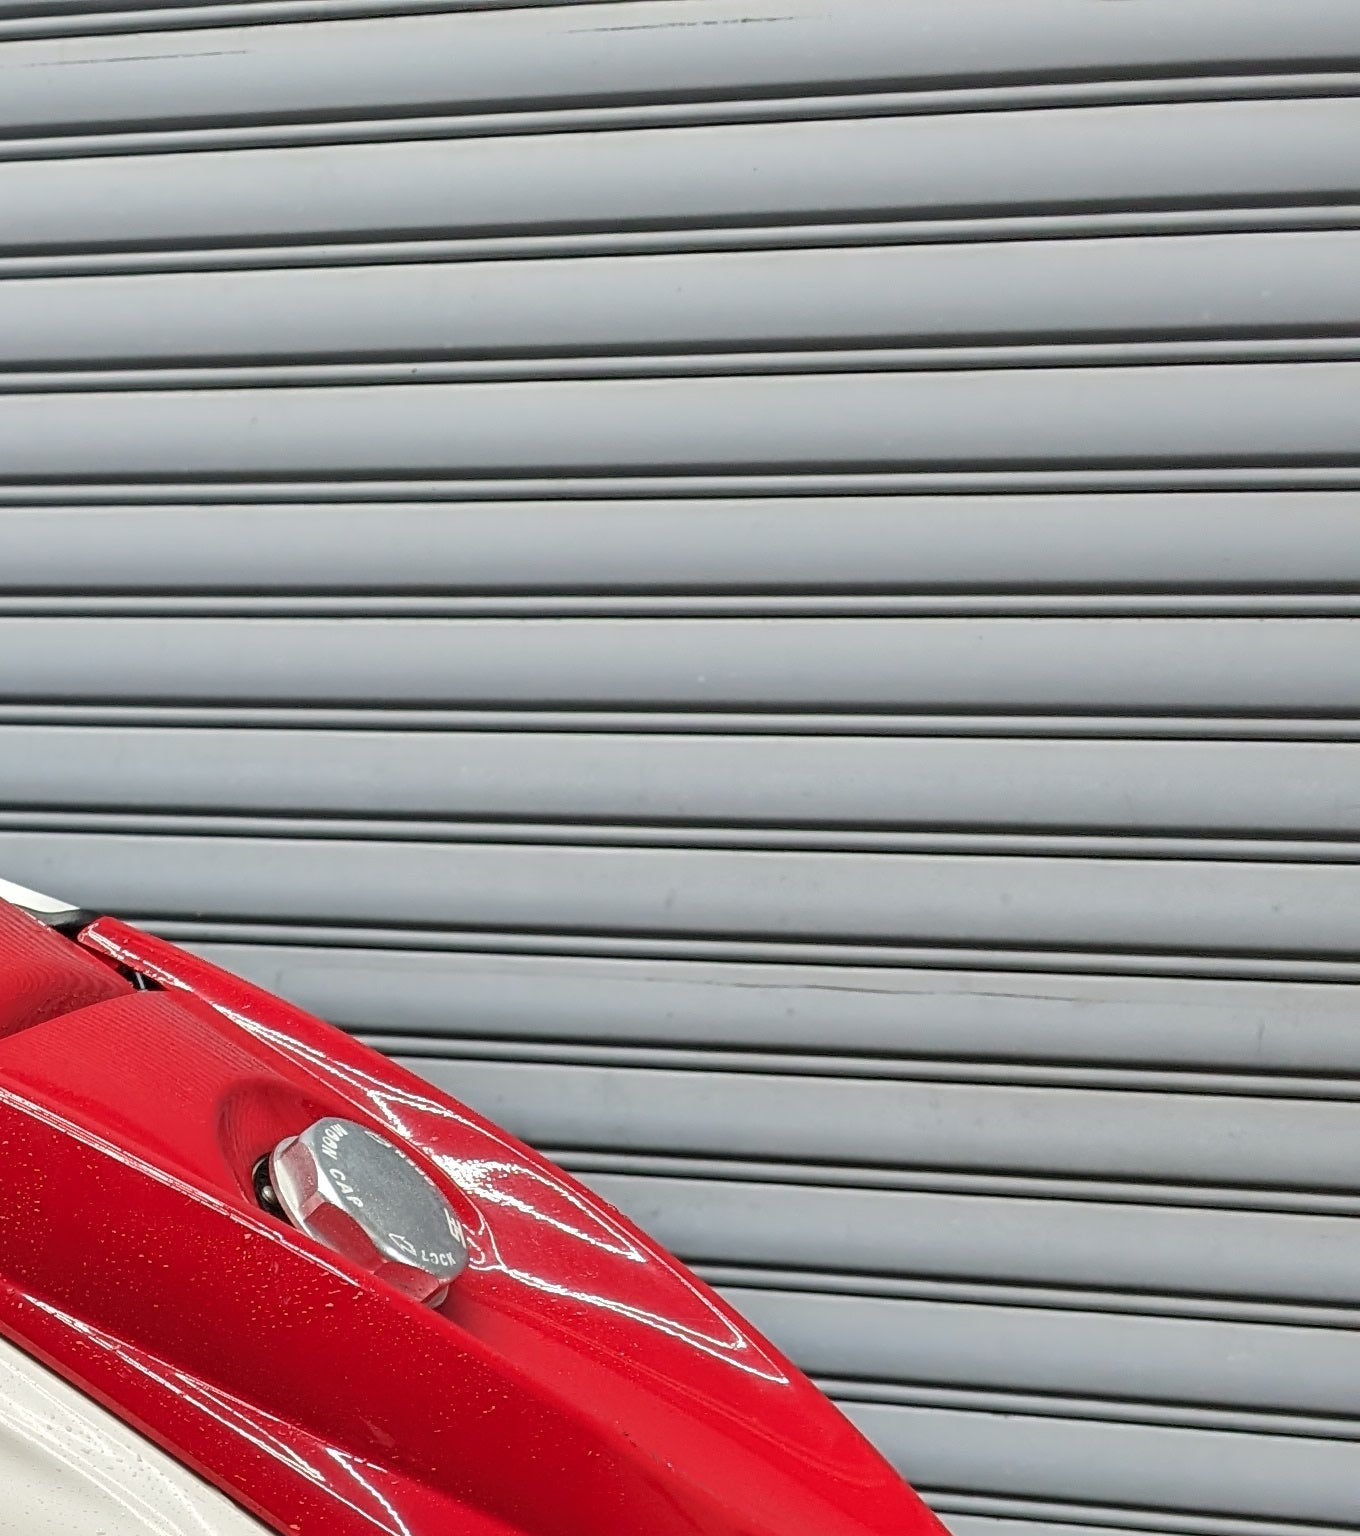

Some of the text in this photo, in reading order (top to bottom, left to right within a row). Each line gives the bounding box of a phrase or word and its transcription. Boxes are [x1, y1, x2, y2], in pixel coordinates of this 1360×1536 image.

[321, 1123, 364, 1208] MOON CAP
[421, 1249, 457, 1267] LOCK
